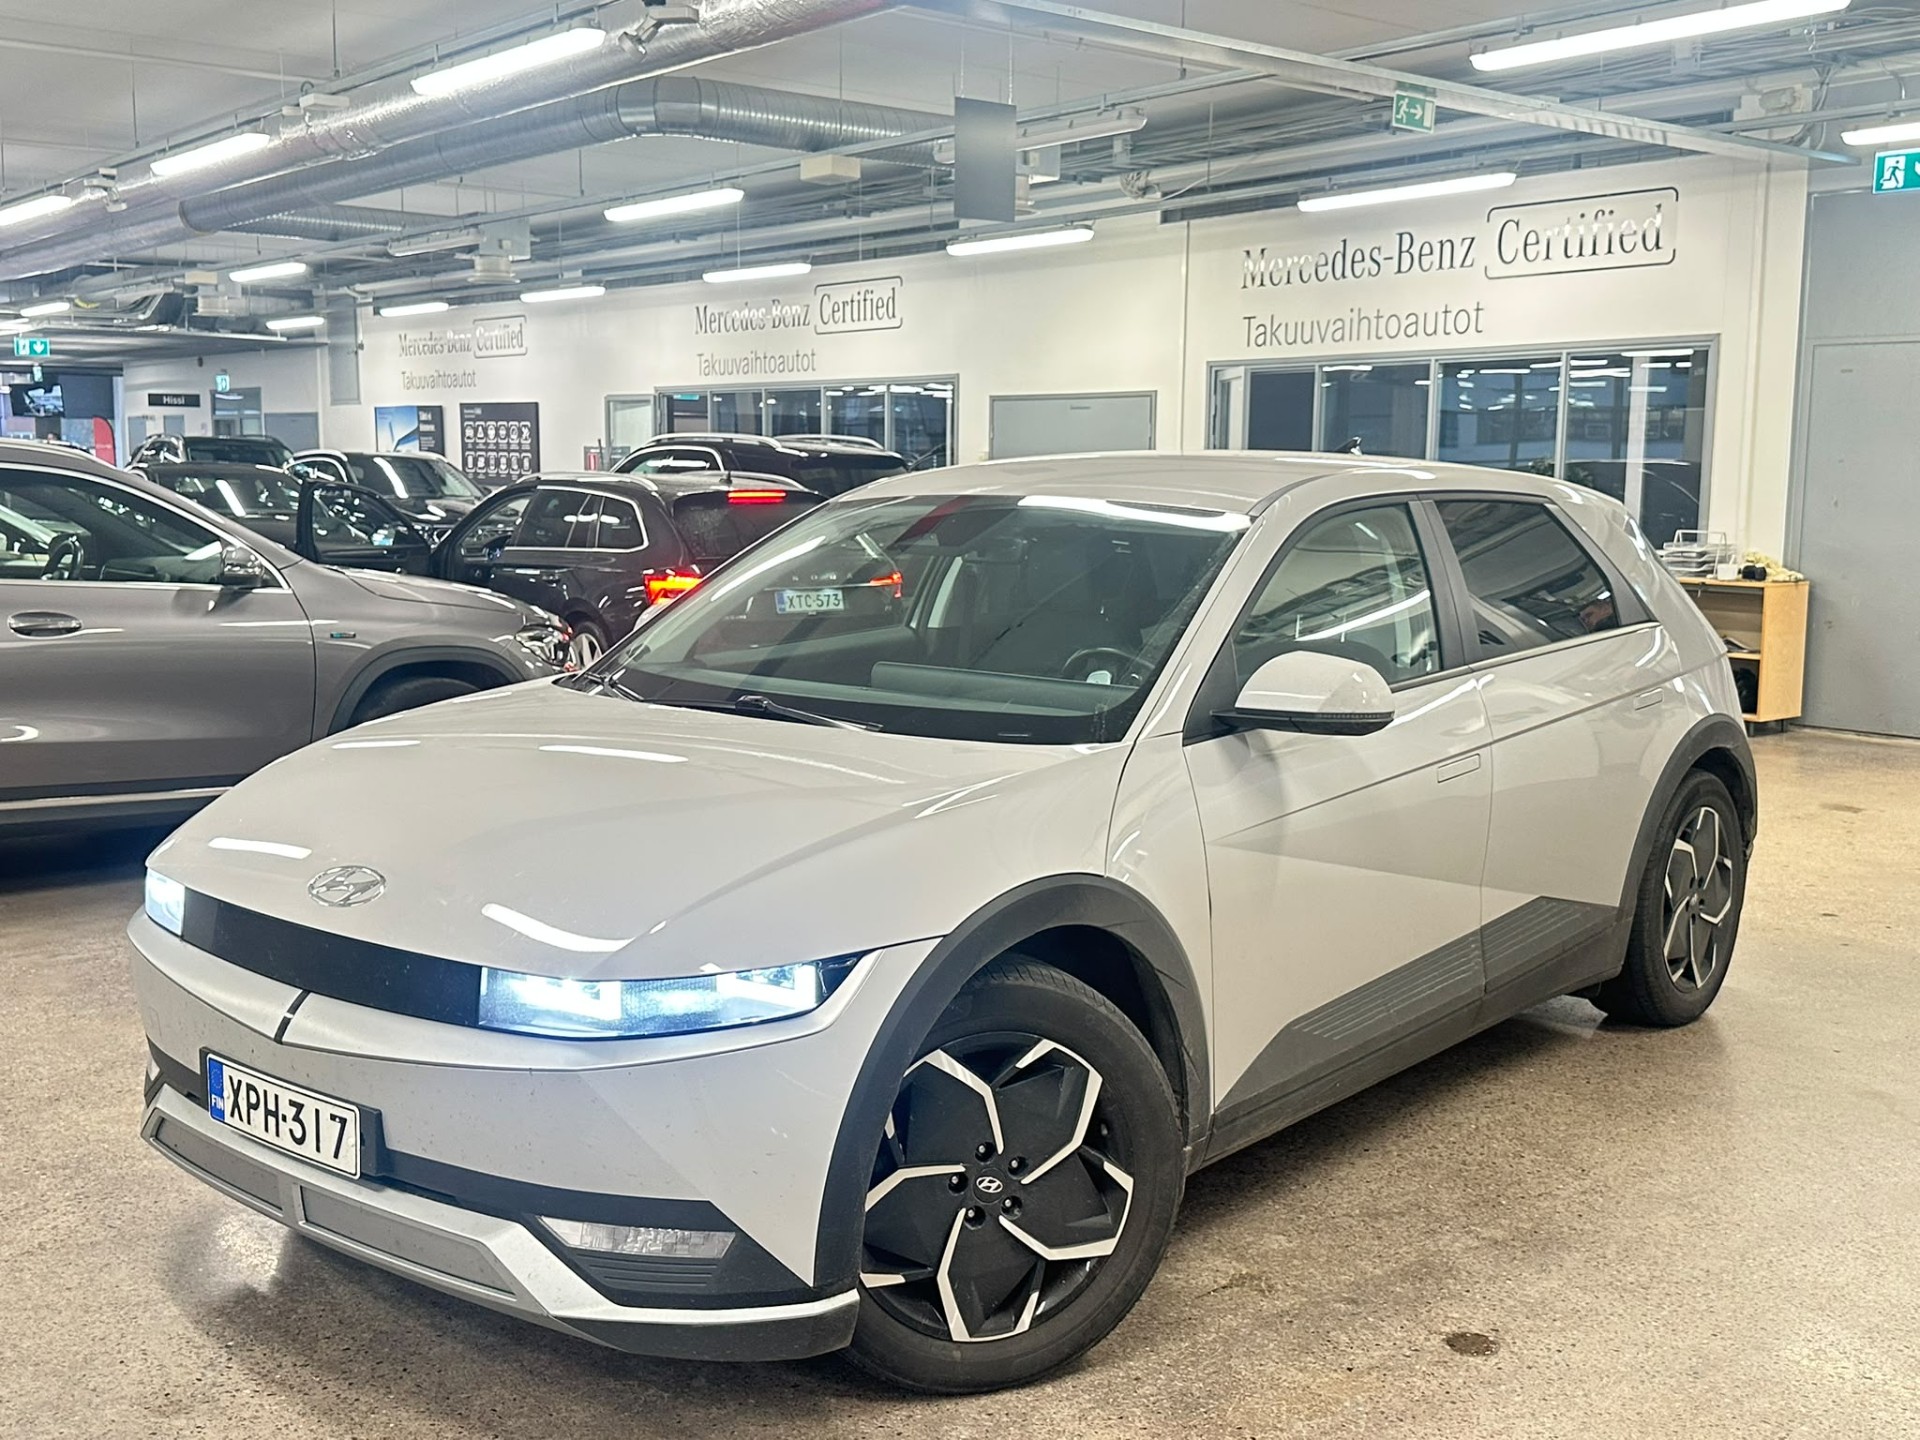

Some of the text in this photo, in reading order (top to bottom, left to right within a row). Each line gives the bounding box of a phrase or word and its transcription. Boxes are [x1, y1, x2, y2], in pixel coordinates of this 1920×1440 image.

[1241, 203, 1664, 289] Mercedes-Benz Certified
[694, 287, 897, 335] Mercedes-Benz Certified
[1243, 301, 1485, 348] Takuuvaihtoautot
[398, 322, 524, 357] Mercedes-Benz Certified
[401, 369, 477, 390] Takuuvaihtoautot
[697, 348, 817, 376] Takuuvaihtoautot
[786, 593, 841, 609] XTC-573
[211, 1094, 224, 1112] FIN
[228, 1075, 347, 1159] XPH-317
